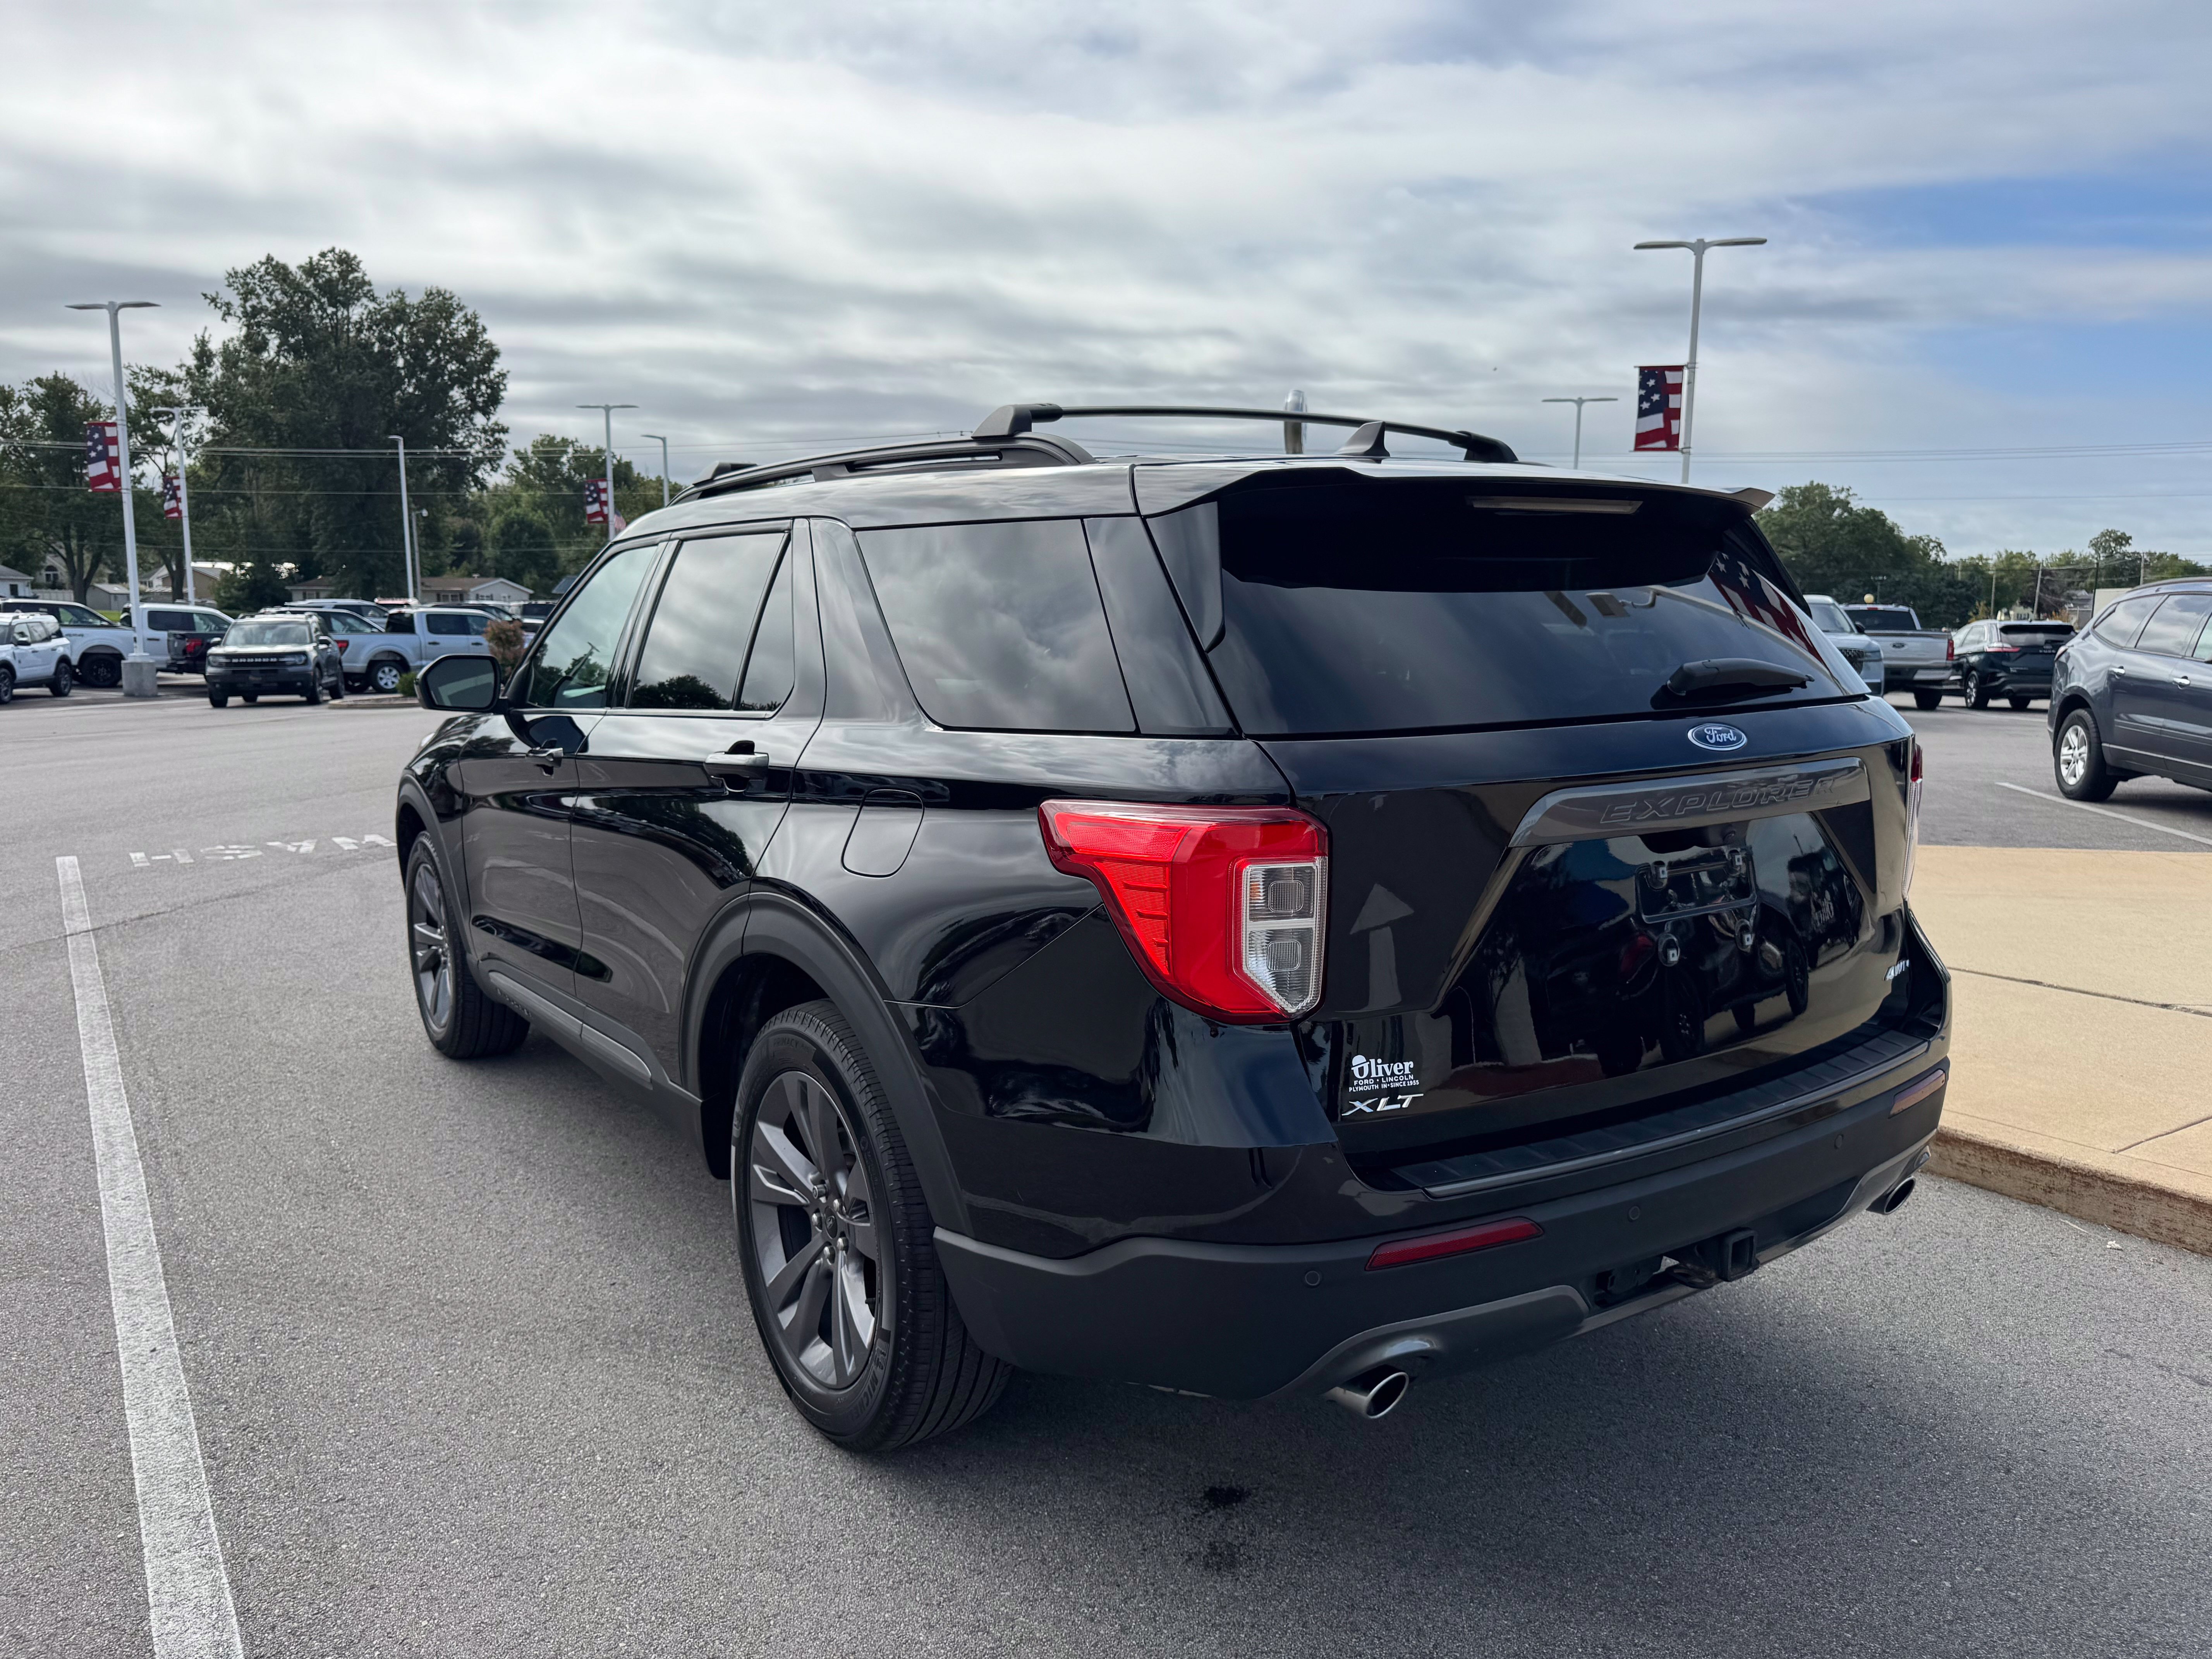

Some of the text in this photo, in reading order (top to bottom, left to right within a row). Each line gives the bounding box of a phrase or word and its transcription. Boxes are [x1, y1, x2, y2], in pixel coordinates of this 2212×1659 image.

[1704, 726, 1736, 744] Ford
[1600, 776, 1837, 824] EXPLORER
[129, 834, 397, 867] WASH
[1351, 1054, 1414, 1079] Oliver
[1349, 1084, 1379, 1092] PLYMOUTH
[1381, 1074, 1414, 1083] LINCOLN
[1341, 1093, 1424, 1116] XLT
